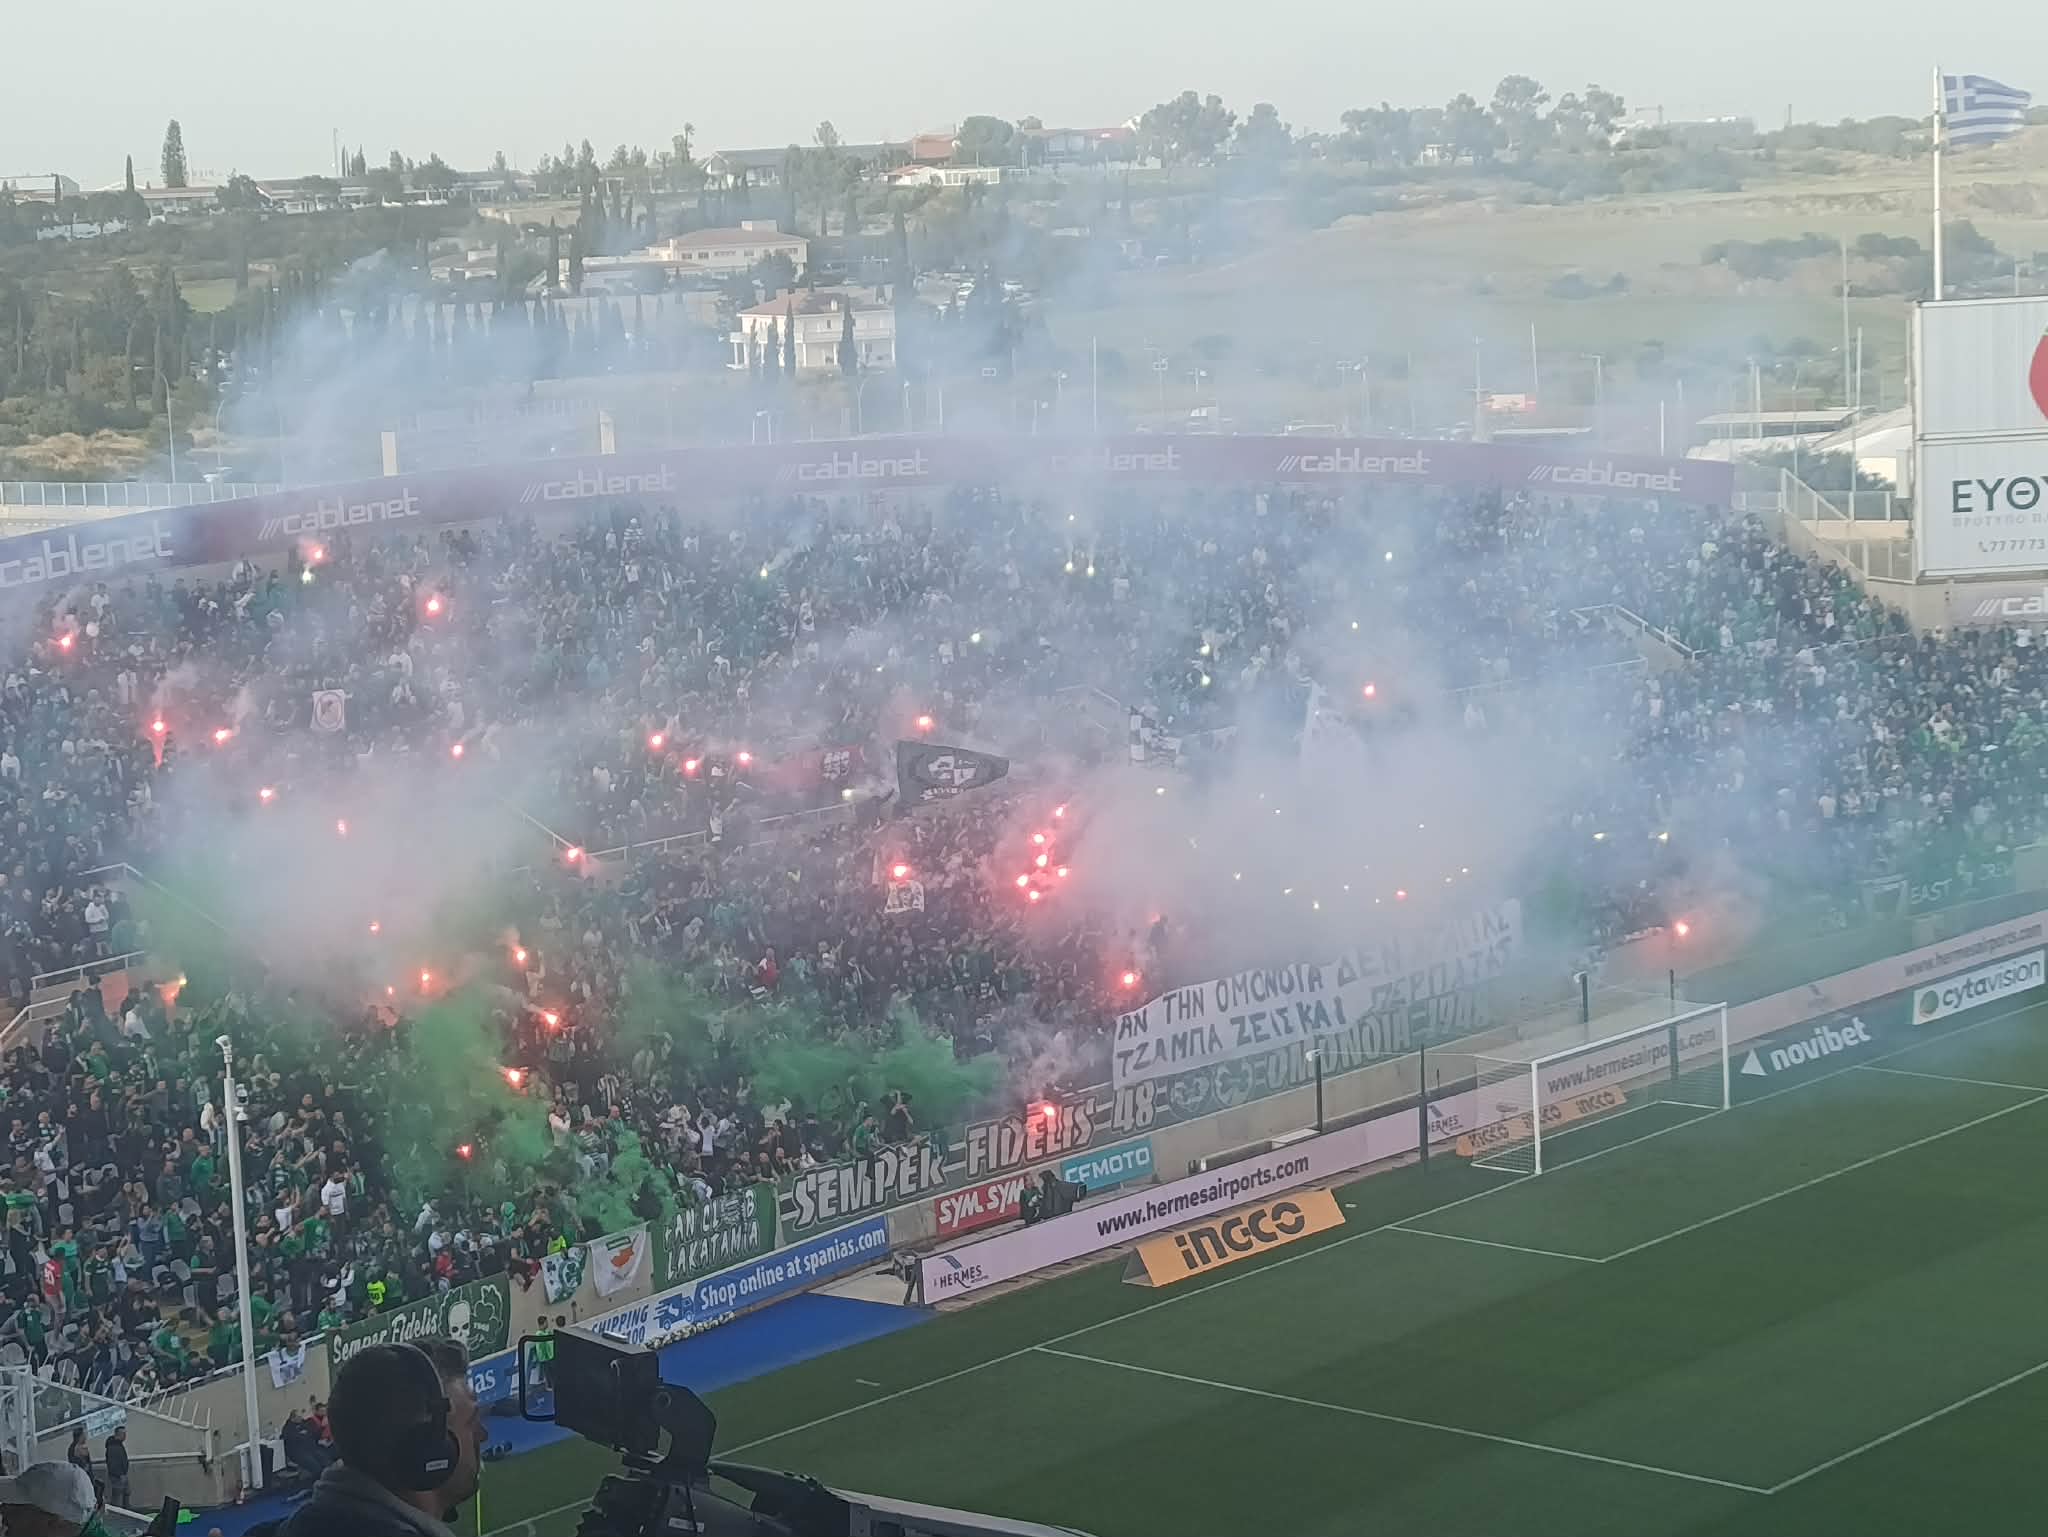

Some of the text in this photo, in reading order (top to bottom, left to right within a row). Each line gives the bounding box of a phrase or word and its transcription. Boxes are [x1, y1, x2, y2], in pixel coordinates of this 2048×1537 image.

[544, 464, 676, 500] cablenet
[799, 448, 929, 480] cablenet
[1301, 448, 1429, 474] cablenet
[1551, 459, 1681, 492] cablenet
[283, 488, 421, 536] cablenet
[1118, 1008, 1147, 1040] ΑΝ
[1163, 988, 1204, 1025] ΤΗΝ
[1216, 965, 1323, 1012] ΟΜΟΝΟΙΑ
[1942, 960, 2040, 1009] cytavision
[1117, 1024, 1223, 1077] ΤΖΑΜΠΑ
[1230, 1007, 1294, 1047] ΖΕΙΣ
[1296, 995, 1346, 1035] ΚΑΙ
[1770, 1017, 1871, 1071] novibet
[967, 1098, 1096, 1175] FIDELIS
[1064, 1147, 1150, 1183] CFMOTO
[702, 1189, 755, 1233] CLB
[938, 1190, 984, 1228] SYM
[1096, 1153, 1310, 1238] www.hermesairports.com
[700, 1227, 886, 1310] Shop online at spanias.com
[940, 1266, 983, 1289] HERMES
[591, 1304, 649, 1334] SHIPPING
